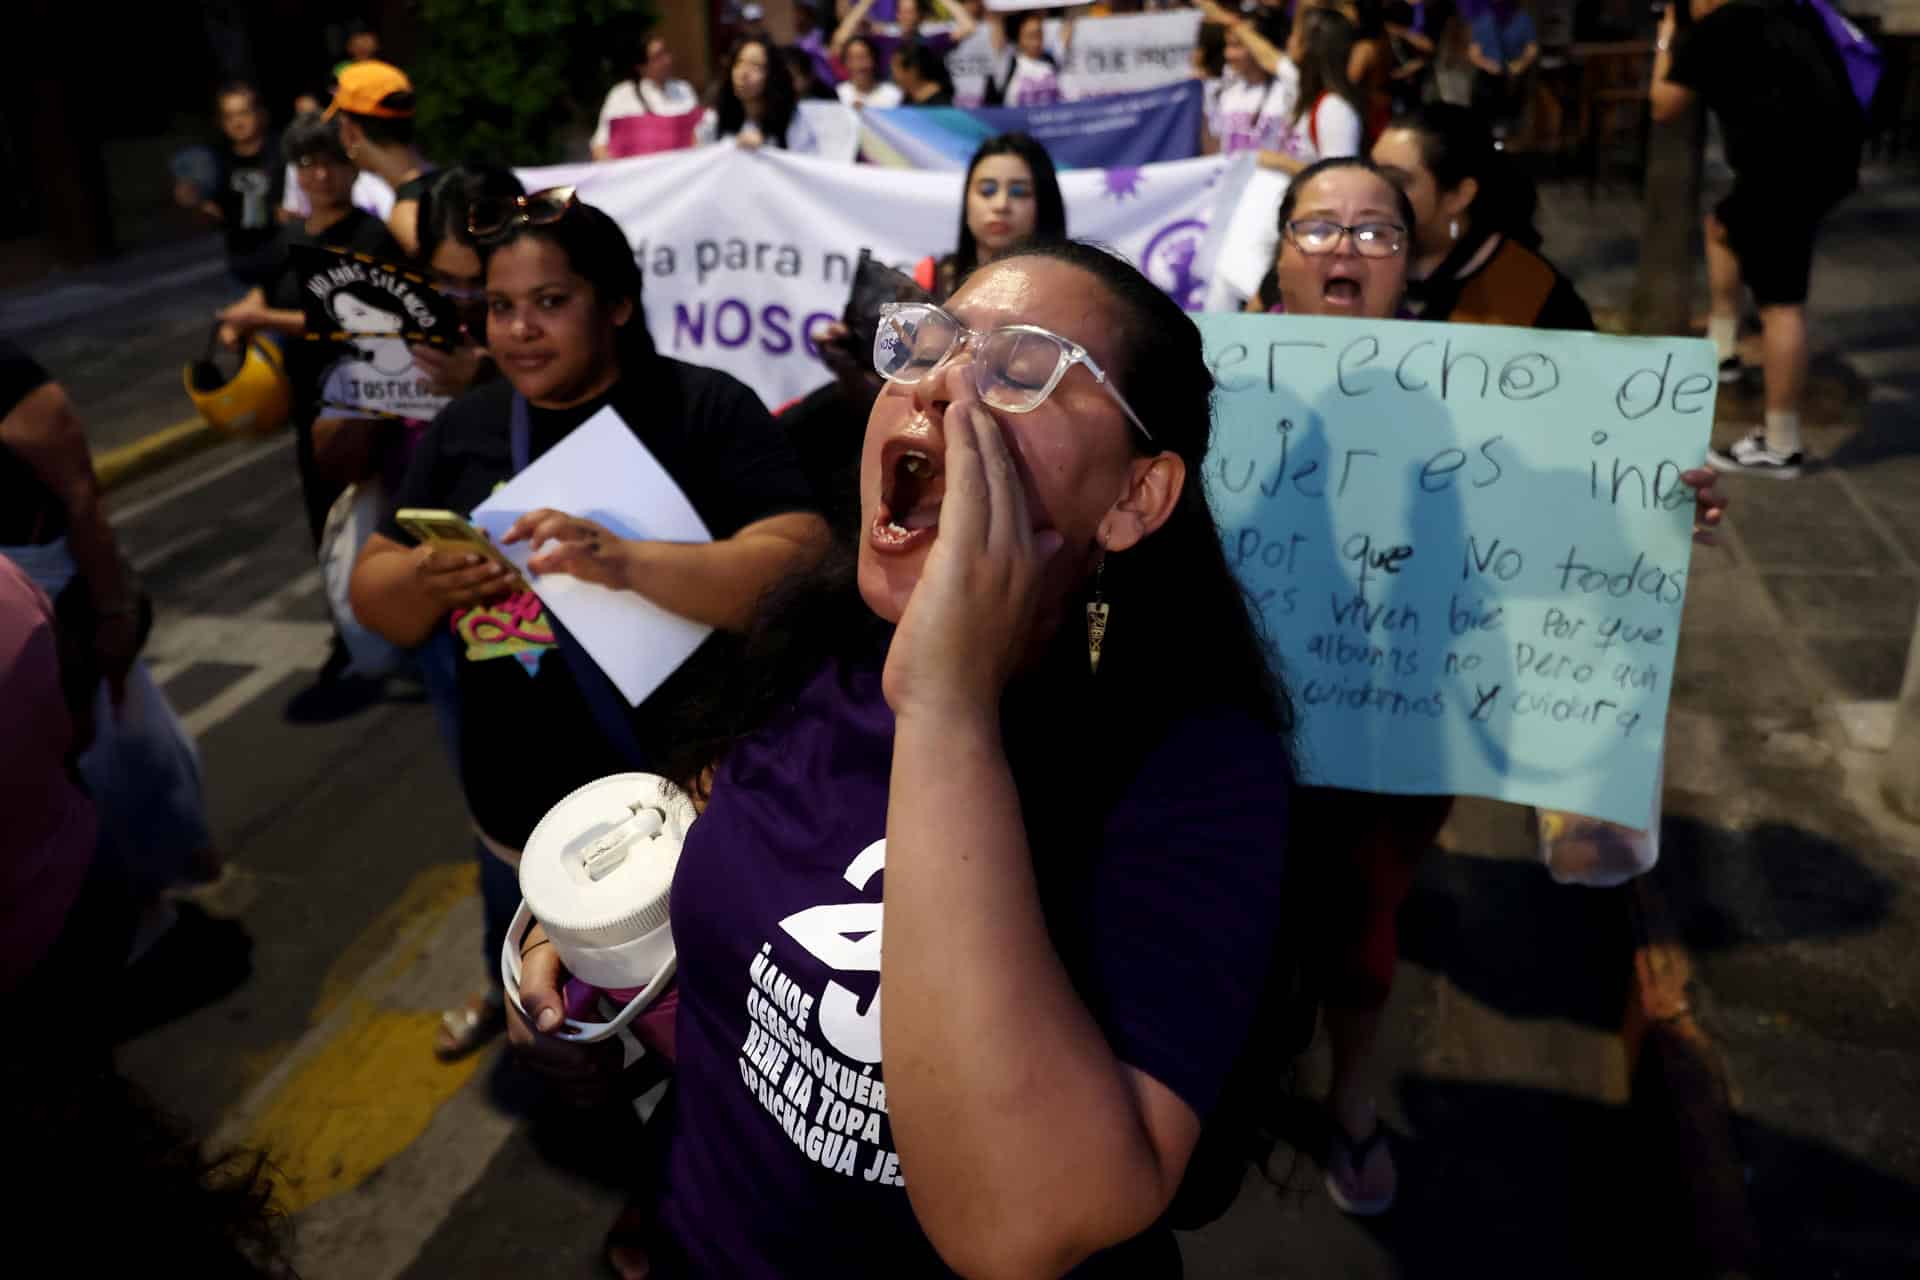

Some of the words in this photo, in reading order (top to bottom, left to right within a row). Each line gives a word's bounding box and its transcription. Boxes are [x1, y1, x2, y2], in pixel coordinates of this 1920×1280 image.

[695, 237, 803, 286] para
[1212, 334, 1560, 402] erecho
[1615, 352, 1714, 420] de
[1342, 532, 1414, 600] que
[1554, 544, 1687, 605] todas
[741, 1019, 790, 1087] REHE
[782, 1061, 814, 1114] HA
[814, 1085, 881, 1145] TOPA
[746, 986, 889, 1115] DERECHOKUÉR
[738, 1056, 859, 1177] OPAICHAGUA
